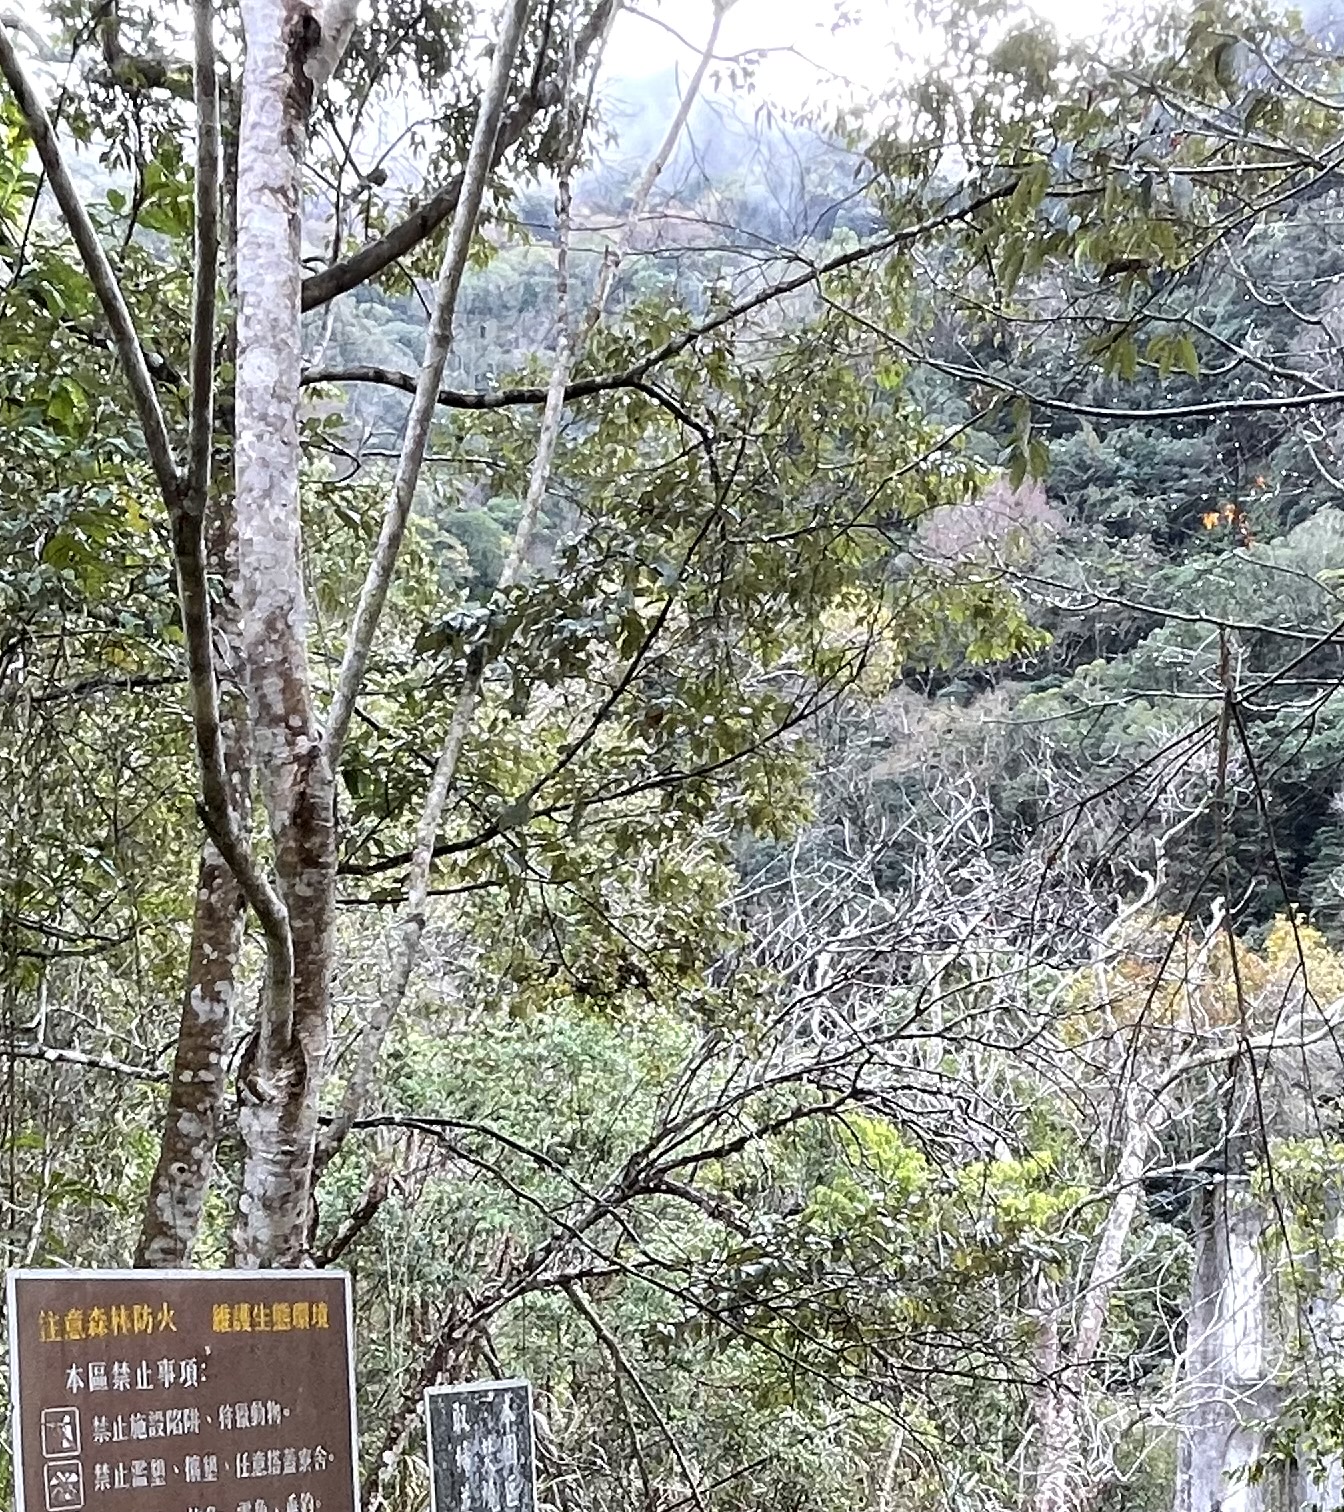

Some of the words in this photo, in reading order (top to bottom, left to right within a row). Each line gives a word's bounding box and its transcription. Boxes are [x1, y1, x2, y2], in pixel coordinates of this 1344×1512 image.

[38, 1302, 178, 1343] 注意森林防火
[212, 1301, 330, 1333] 維護生態環境
